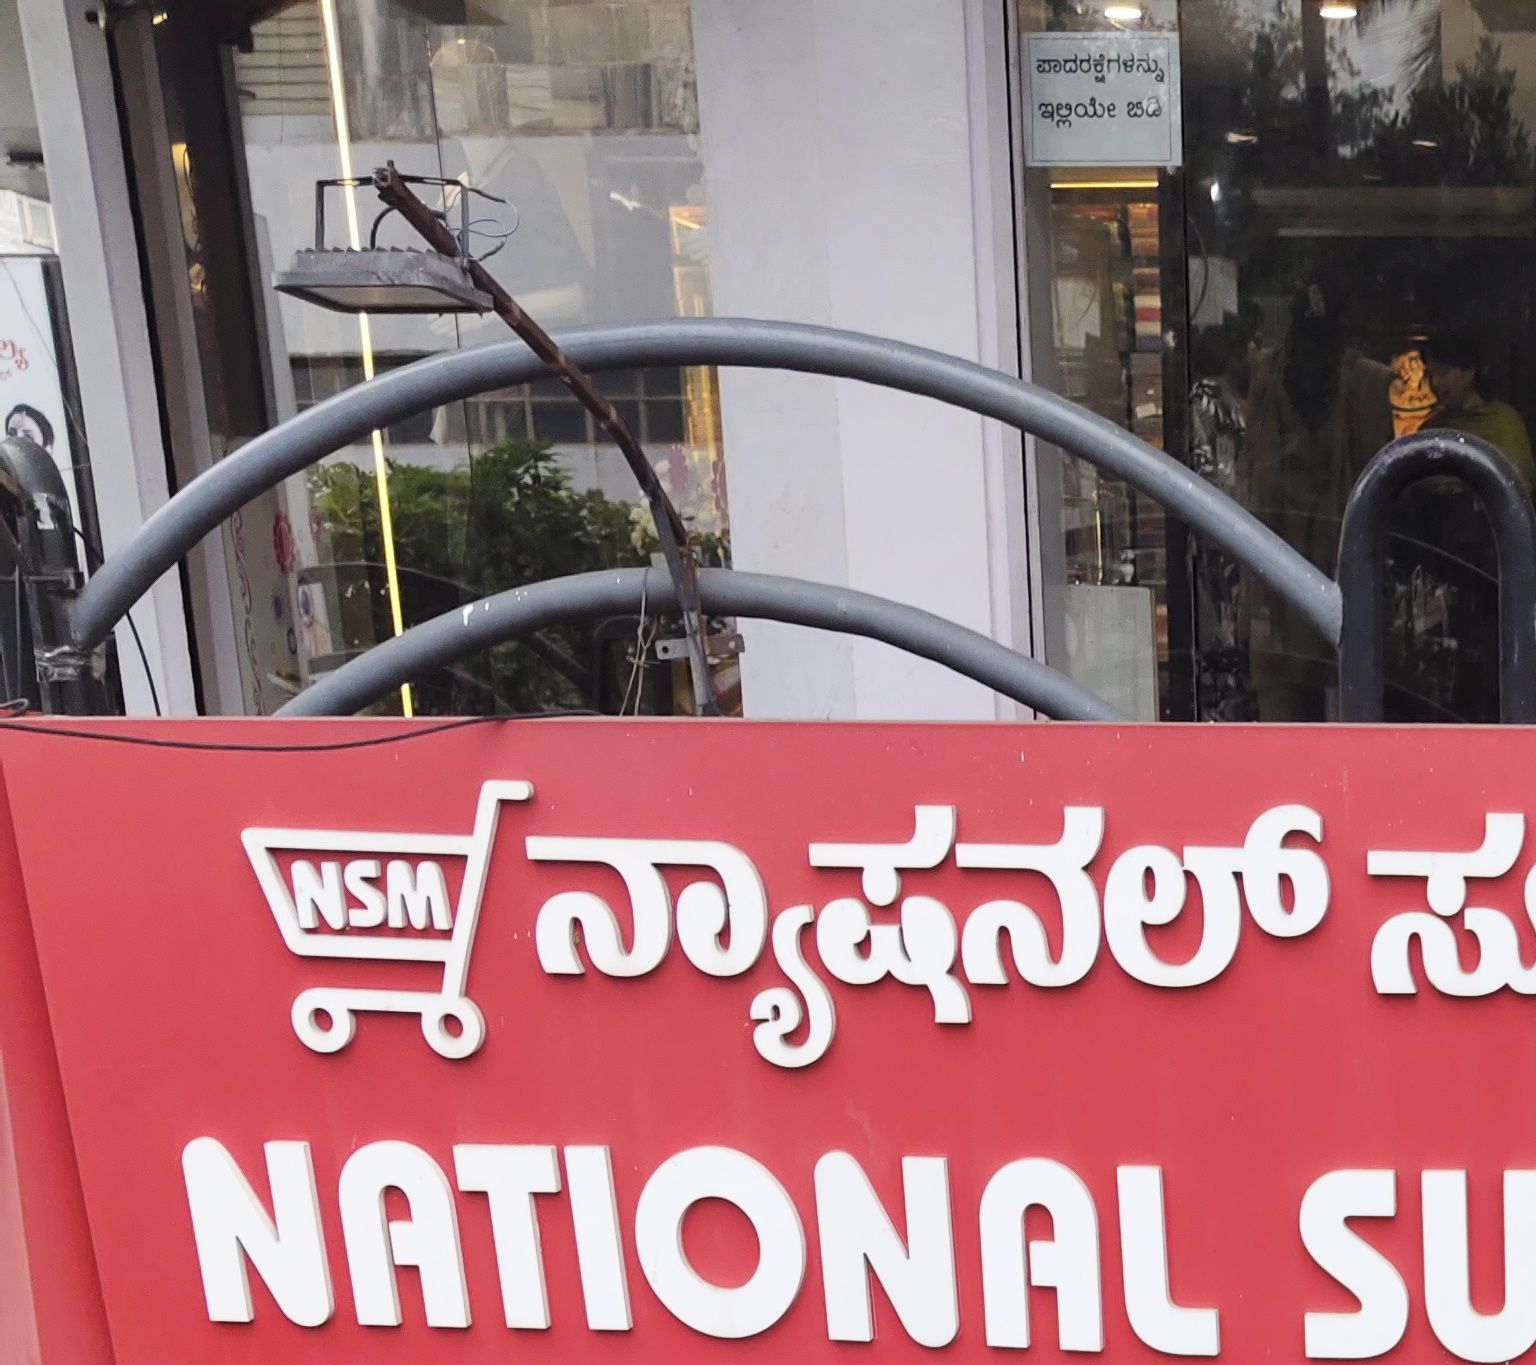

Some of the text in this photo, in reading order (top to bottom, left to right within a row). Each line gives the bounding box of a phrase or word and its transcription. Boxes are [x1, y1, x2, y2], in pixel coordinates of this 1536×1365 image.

[290, 859, 452, 931] NSM
[525, 804, 1332, 1069] ನ್ಯಾಷನಲ್
[182, 1136, 1220, 1358] NATIONAL
